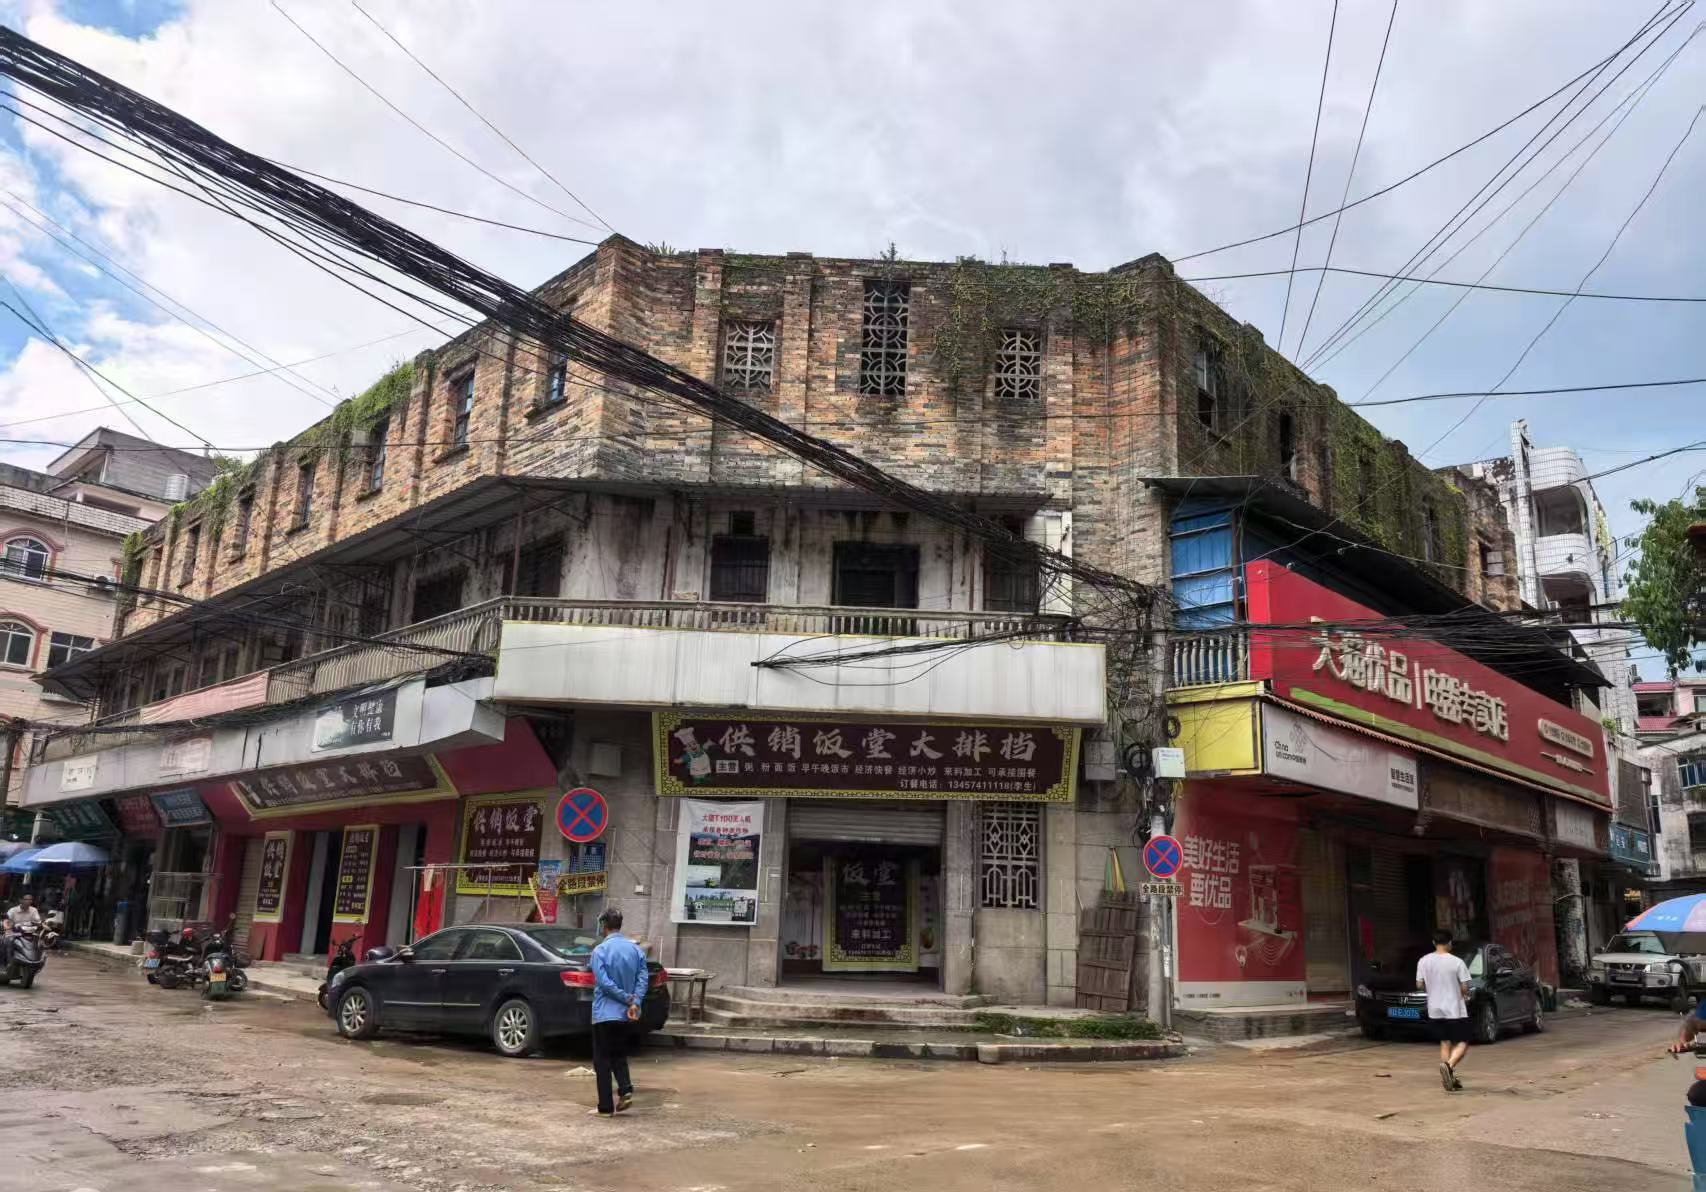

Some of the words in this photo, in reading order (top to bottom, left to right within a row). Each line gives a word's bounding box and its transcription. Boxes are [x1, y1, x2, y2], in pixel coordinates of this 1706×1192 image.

[719, 724, 1037, 763] 供销饭堂大排档
[1183, 835, 1240, 874] 美好生活
[1142, 883, 1183, 895] 全路段禁停
[1190, 872, 1232, 908] 要优品
